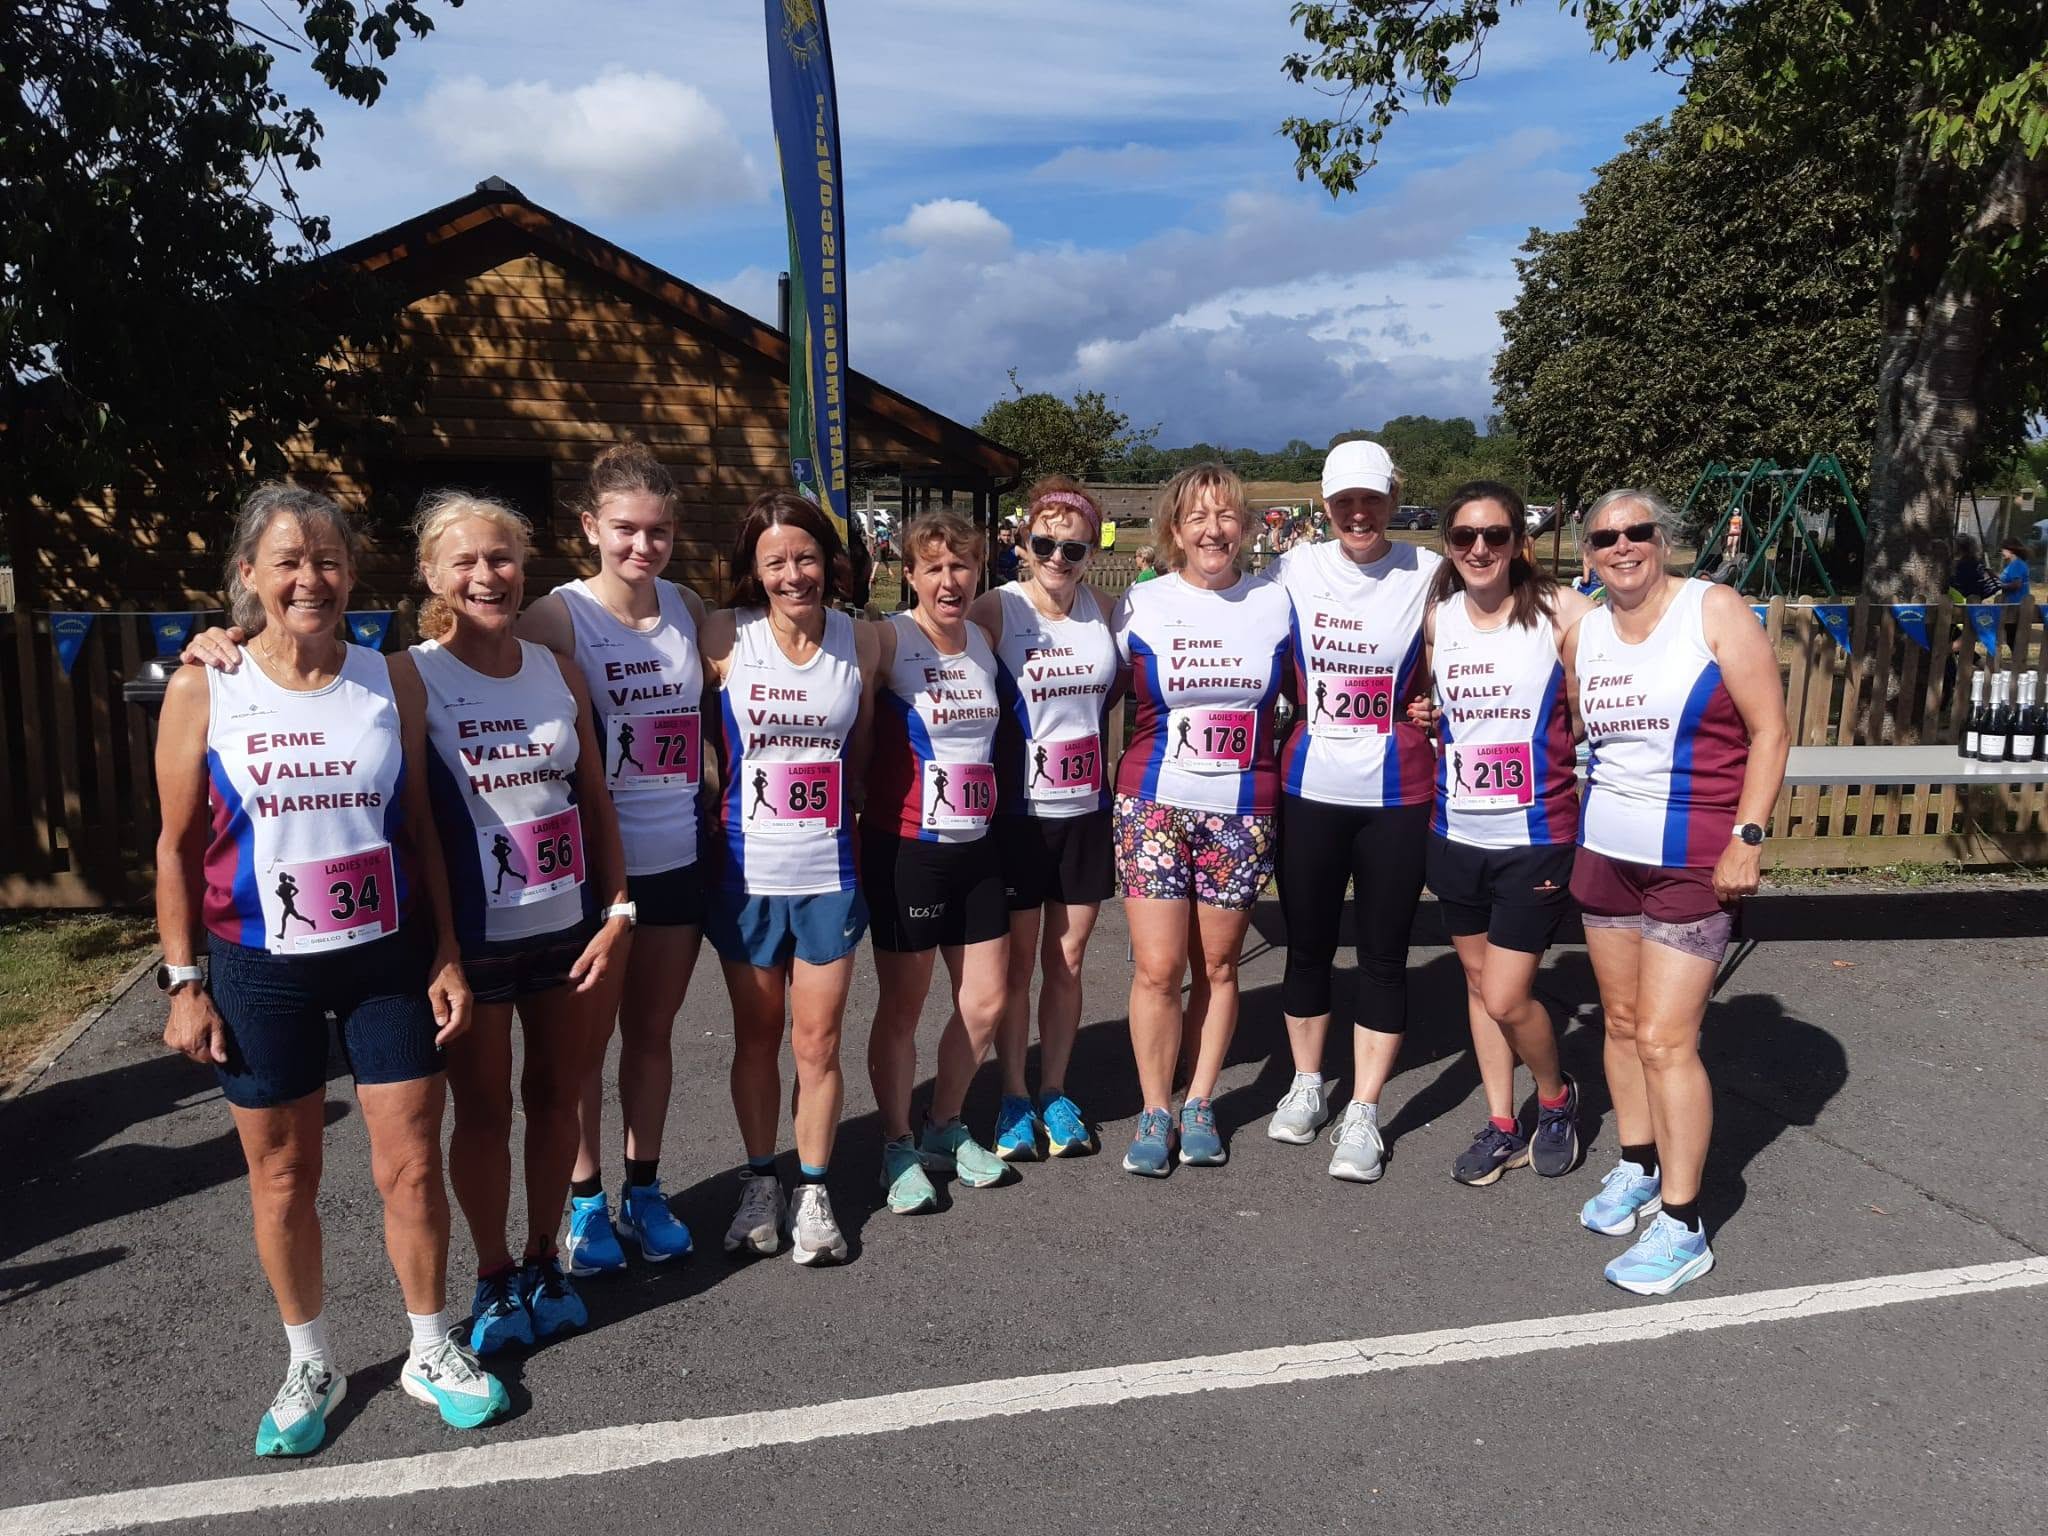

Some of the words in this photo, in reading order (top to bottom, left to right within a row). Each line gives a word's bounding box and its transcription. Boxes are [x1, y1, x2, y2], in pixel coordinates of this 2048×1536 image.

[1314, 612, 1363, 631] ERME
[1173, 638, 1223, 651] ERME
[1311, 634, 1379, 654] VALLEY
[1025, 647, 1074, 661] ERME
[1171, 656, 1243, 670] VALLEY
[605, 660, 662, 681] ERME
[1027, 664, 1095, 682] VALLEY
[1311, 656, 1394, 674] HARRIERS
[1447, 663, 1495, 679] ERME
[923, 668, 967, 683] ERME
[1168, 677, 1262, 692] HARRIERS
[1344, 679, 1369, 687] LADIES
[1370, 679, 1384, 687] 10K
[1587, 674, 1633, 691] ERME
[608, 682, 684, 707] VALLEY
[750, 684, 807, 701] ERME
[927, 689, 983, 704] VALLEY
[1031, 684, 1108, 702] HARRIERS
[1446, 685, 1513, 701] VALLEY
[1334, 692, 1389, 719] 206
[1584, 694, 1647, 714] VALLEY
[747, 708, 828, 727] VALLEY
[1208, 713, 1233, 721] LADIES
[1452, 707, 1531, 723] HARRIERS
[458, 719, 527, 738] ERME
[1588, 718, 1670, 737] HARRIERS
[247, 732, 326, 755] ERME
[748, 733, 841, 750] HARRIERS
[1203, 726, 1247, 754] 178
[460, 743, 556, 766] VALLEY
[655, 734, 688, 767] 72
[1477, 748, 1503, 756] LADIES
[1505, 746, 1520, 754] 10K
[247, 760, 357, 786] VALLEY
[788, 767, 816, 775] LADIES
[1060, 751, 1096, 781] 137
[1473, 759, 1525, 789] 213
[789, 780, 828, 812] 85
[962, 780, 990, 809] 119
[256, 792, 381, 818] HARRIERS
[536, 833, 574, 875] 56
[325, 862, 360, 875] LADIES
[328, 874, 380, 921] 34
